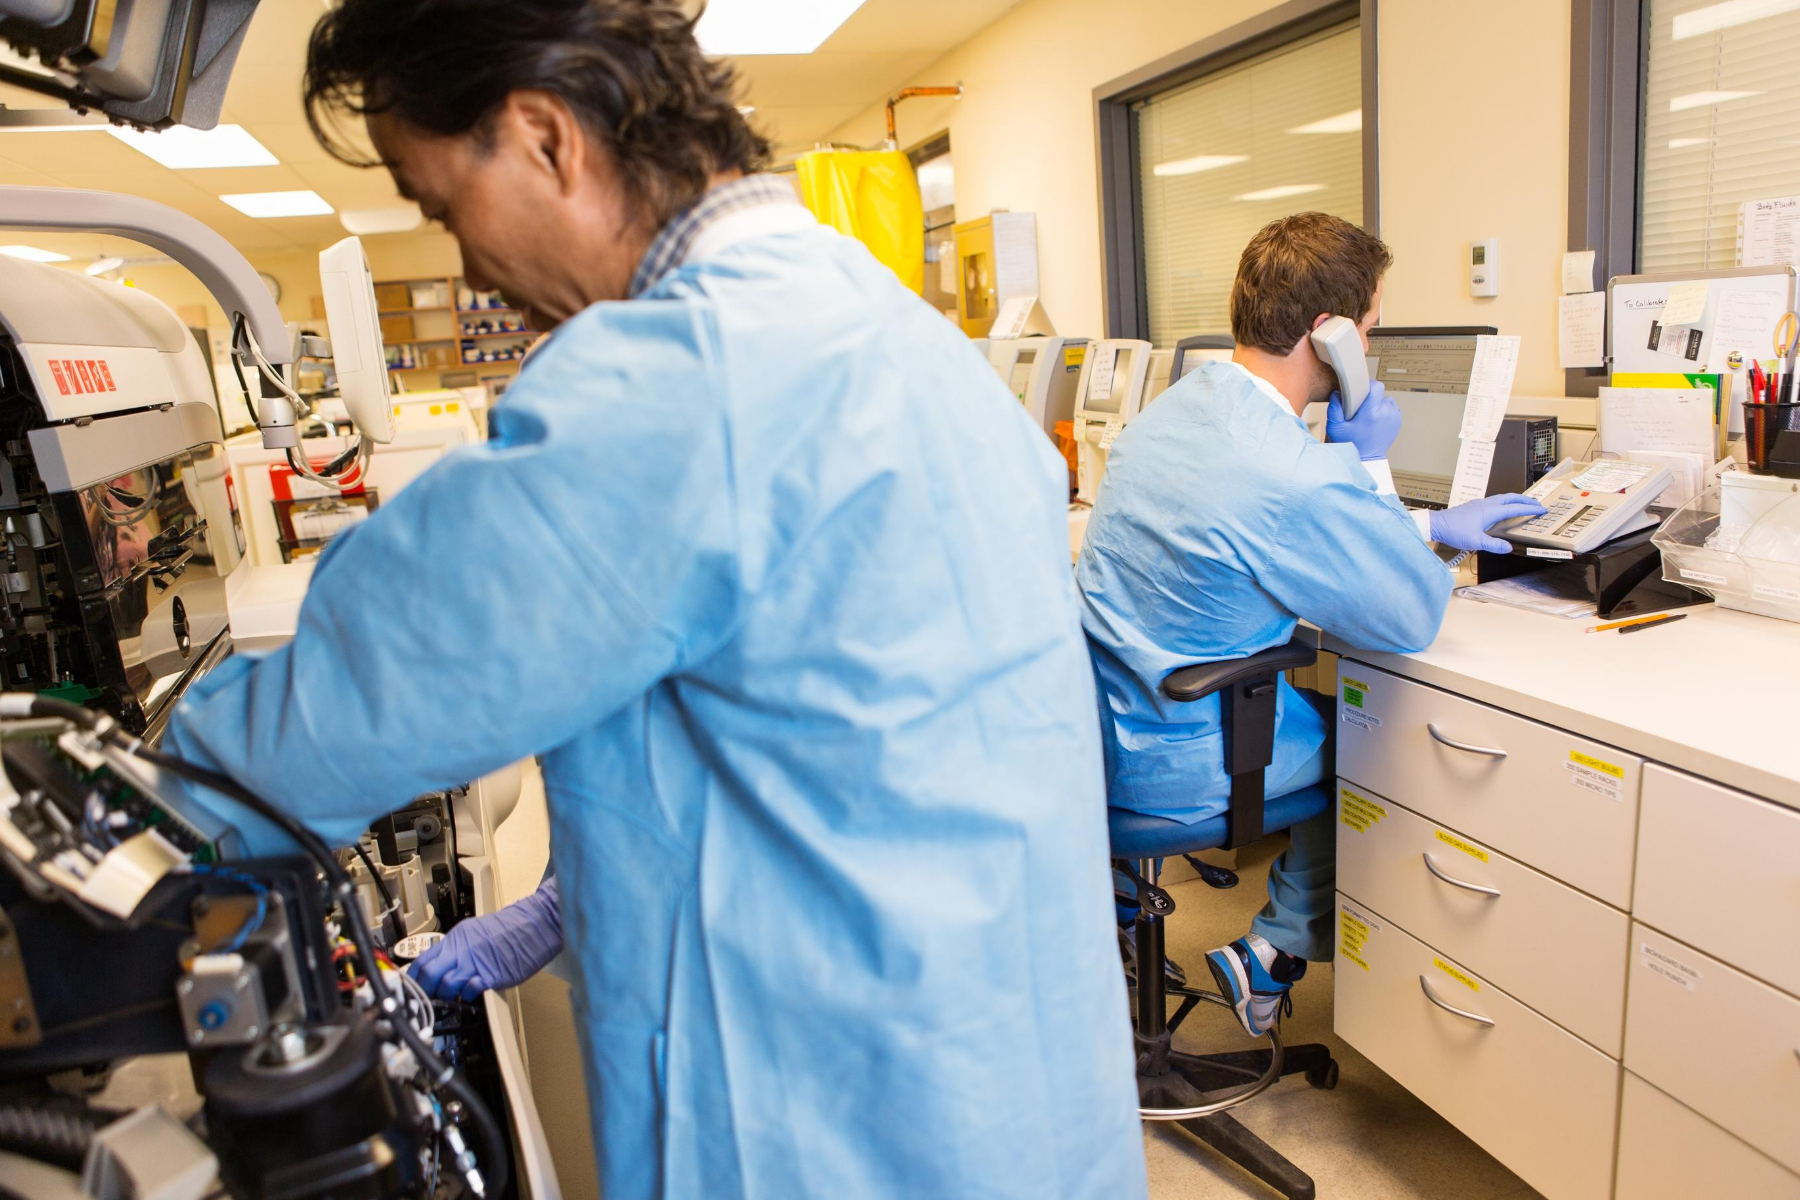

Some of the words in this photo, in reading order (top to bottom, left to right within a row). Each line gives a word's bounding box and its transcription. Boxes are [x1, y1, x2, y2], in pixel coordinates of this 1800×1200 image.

[1774, 199, 1796, 208] Fluids
[1624, 300, 1633, 308] To
[1345, 715, 1368, 729] CALCULATOR
[1346, 707, 1367, 719] PROCEDURE
[1584, 757, 1600, 767] LIGHT
[1601, 763, 1620, 775] BULBS
[1576, 766, 1597, 779] SAMPLE
[1598, 775, 1617, 787] RACKS
[1585, 782, 1603, 793] MICRO
[1604, 788, 1616, 798] TIPS
[1439, 832, 1453, 843] BLOOD
[1463, 844, 1484, 859] SUPPLIES
[1645, 946, 1678, 968] BIOHAZARD
[1438, 961, 1454, 974] STATUS
[1454, 971, 1475, 988] SUPPLIES
[1647, 962, 1663, 975] HOLE
[1664, 970, 1687, 985] PUNCH
